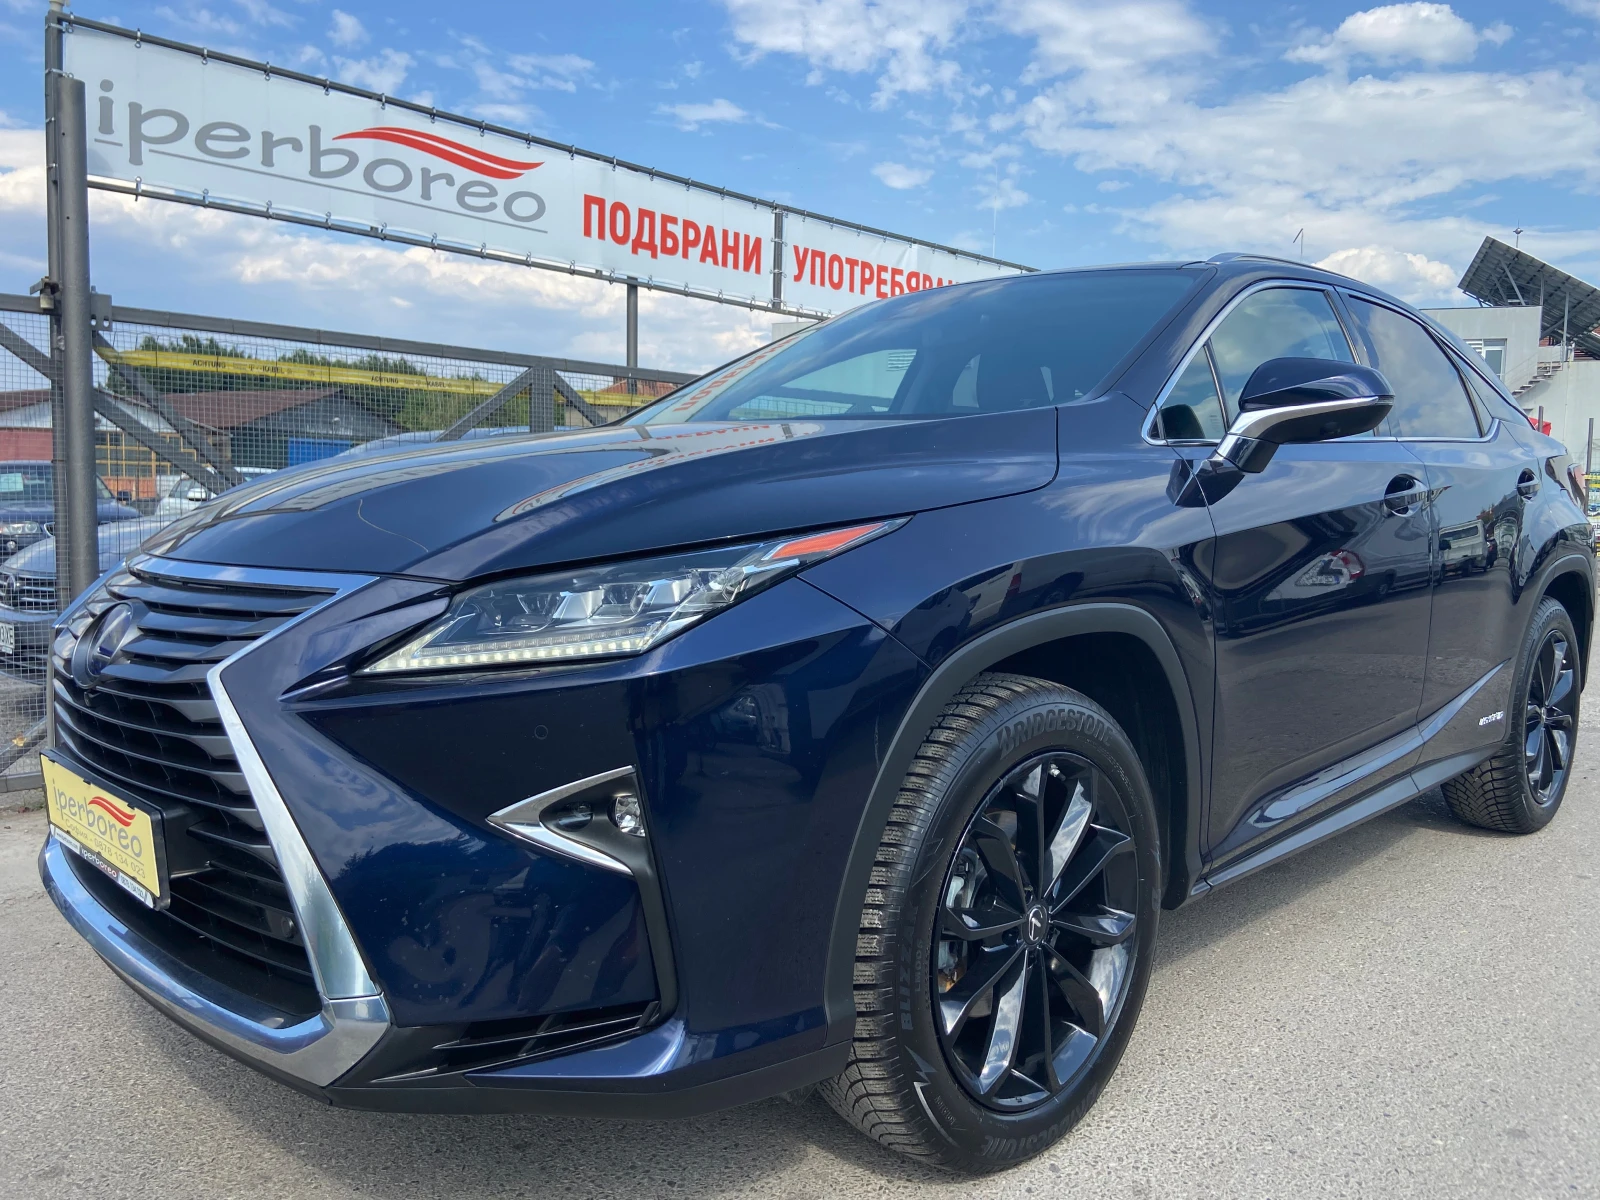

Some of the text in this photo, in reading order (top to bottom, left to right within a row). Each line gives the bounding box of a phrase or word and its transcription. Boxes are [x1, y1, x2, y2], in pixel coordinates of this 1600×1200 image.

[98, 79, 547, 223] iperboreo
[582, 193, 763, 276] ПОДБРАНИ
[192, 359, 226, 368] ACHTUNG
[996, 708, 1114, 757] BRIDGESTONE
[52, 779, 143, 858] iperboreo
[80, 844, 118, 878] iperboreo
